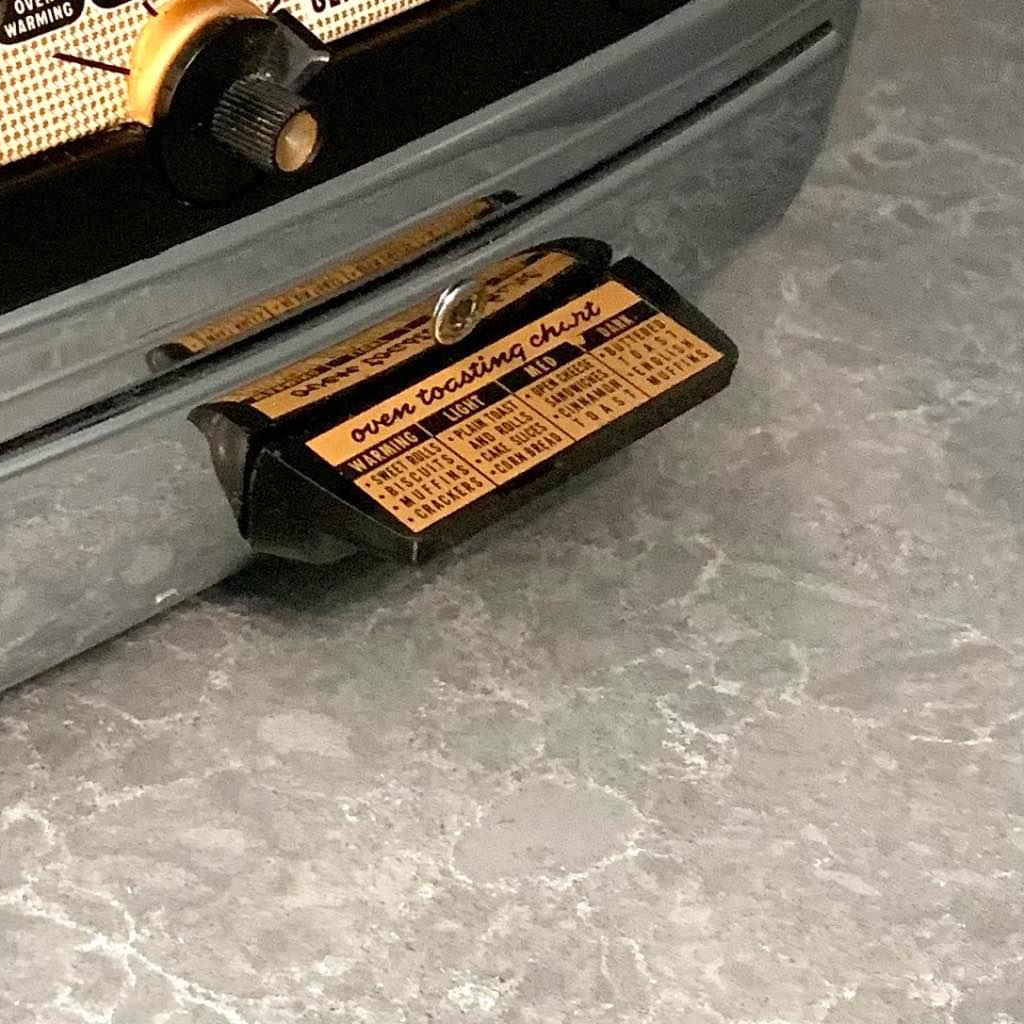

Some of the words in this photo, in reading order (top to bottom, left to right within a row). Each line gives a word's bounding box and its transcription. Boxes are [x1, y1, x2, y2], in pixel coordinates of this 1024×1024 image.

[4, 2, 74, 39] WARMING
[596, 313, 635, 337] DARK
[604, 318, 667, 358] BUTTERED
[351, 402, 417, 443] oven
[416, 342, 526, 405] toasting
[529, 300, 601, 348] chart
[523, 356, 558, 378] MED
[530, 379, 559, 399] OPEN
[559, 358, 595, 383] CHEESE
[632, 341, 696, 377] ENGLISH
[645, 348, 710, 387] MUFFINS
[442, 394, 486, 422] LIGHT
[543, 368, 610, 408] SANDWICHES
[558, 380, 623, 419] CINNAMON
[572, 388, 637, 427] TOAST
[454, 417, 485, 441] PLAIN
[485, 399, 520, 425] TOAST
[471, 430, 497, 450] AND
[499, 410, 534, 437] ROLLS
[347, 431, 419, 473] WARMING
[480, 442, 510, 463] CAKE
[514, 423, 548, 447] SLICES
[494, 452, 526, 474] CORN
[526, 431, 563, 458] BREAD
[369, 459, 408, 486] SWEET
[407, 441, 443, 466] ROLLS
[388, 453, 456, 497] BISCUITS
[399, 464, 471, 509] MUFFINS
[414, 476, 484, 520] CRACKERS
